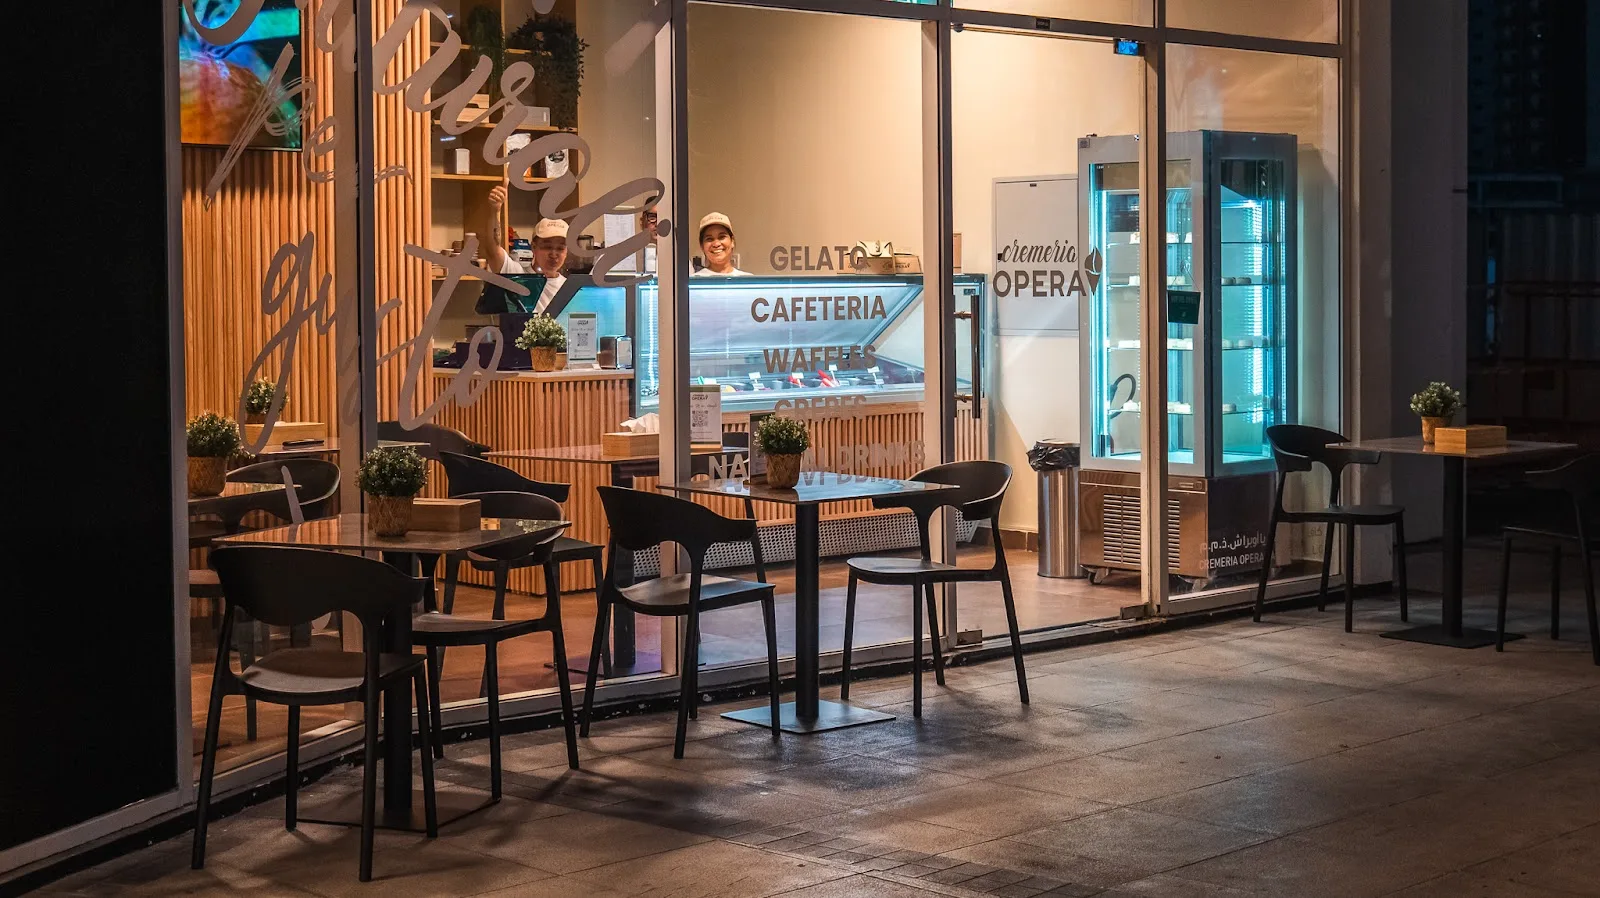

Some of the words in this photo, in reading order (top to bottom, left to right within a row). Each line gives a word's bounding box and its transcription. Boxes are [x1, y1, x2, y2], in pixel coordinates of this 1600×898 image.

[204, 41, 413, 212] pe
[769, 245, 868, 271] GELATO
[998, 239, 1077, 263] cremeria
[992, 270, 1087, 297] OPERA
[750, 295, 888, 323] CAFETERIA
[762, 345, 877, 374] WAFFLES
[708, 447, 831, 480] NAAL
[838, 440, 926, 470] DRINKS
[1198, 555, 1239, 570] CREMERIA
[1239, 551, 1265, 565] OPERA
